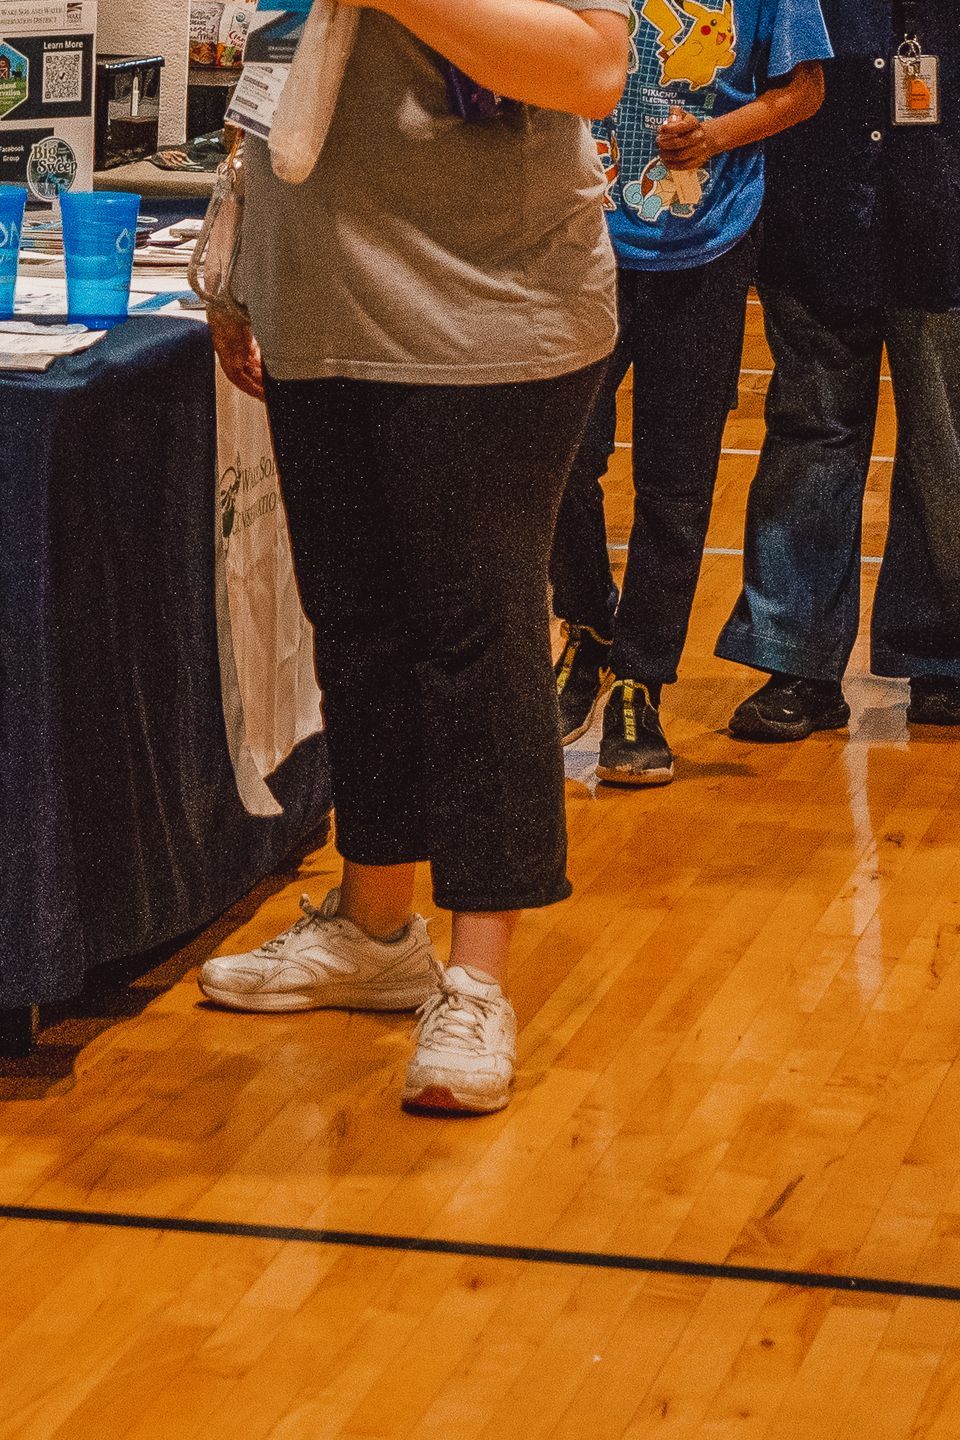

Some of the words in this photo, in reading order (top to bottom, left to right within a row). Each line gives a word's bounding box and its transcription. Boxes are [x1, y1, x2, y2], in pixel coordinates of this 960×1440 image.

[43, 41, 63, 50] Learn
[64, 40, 84, 49] More
[642, 87, 677, 99] PIKACHU
[32, 143, 59, 162] Big
[2, 155, 20, 163] Group
[37, 159, 78, 175] Sweep
